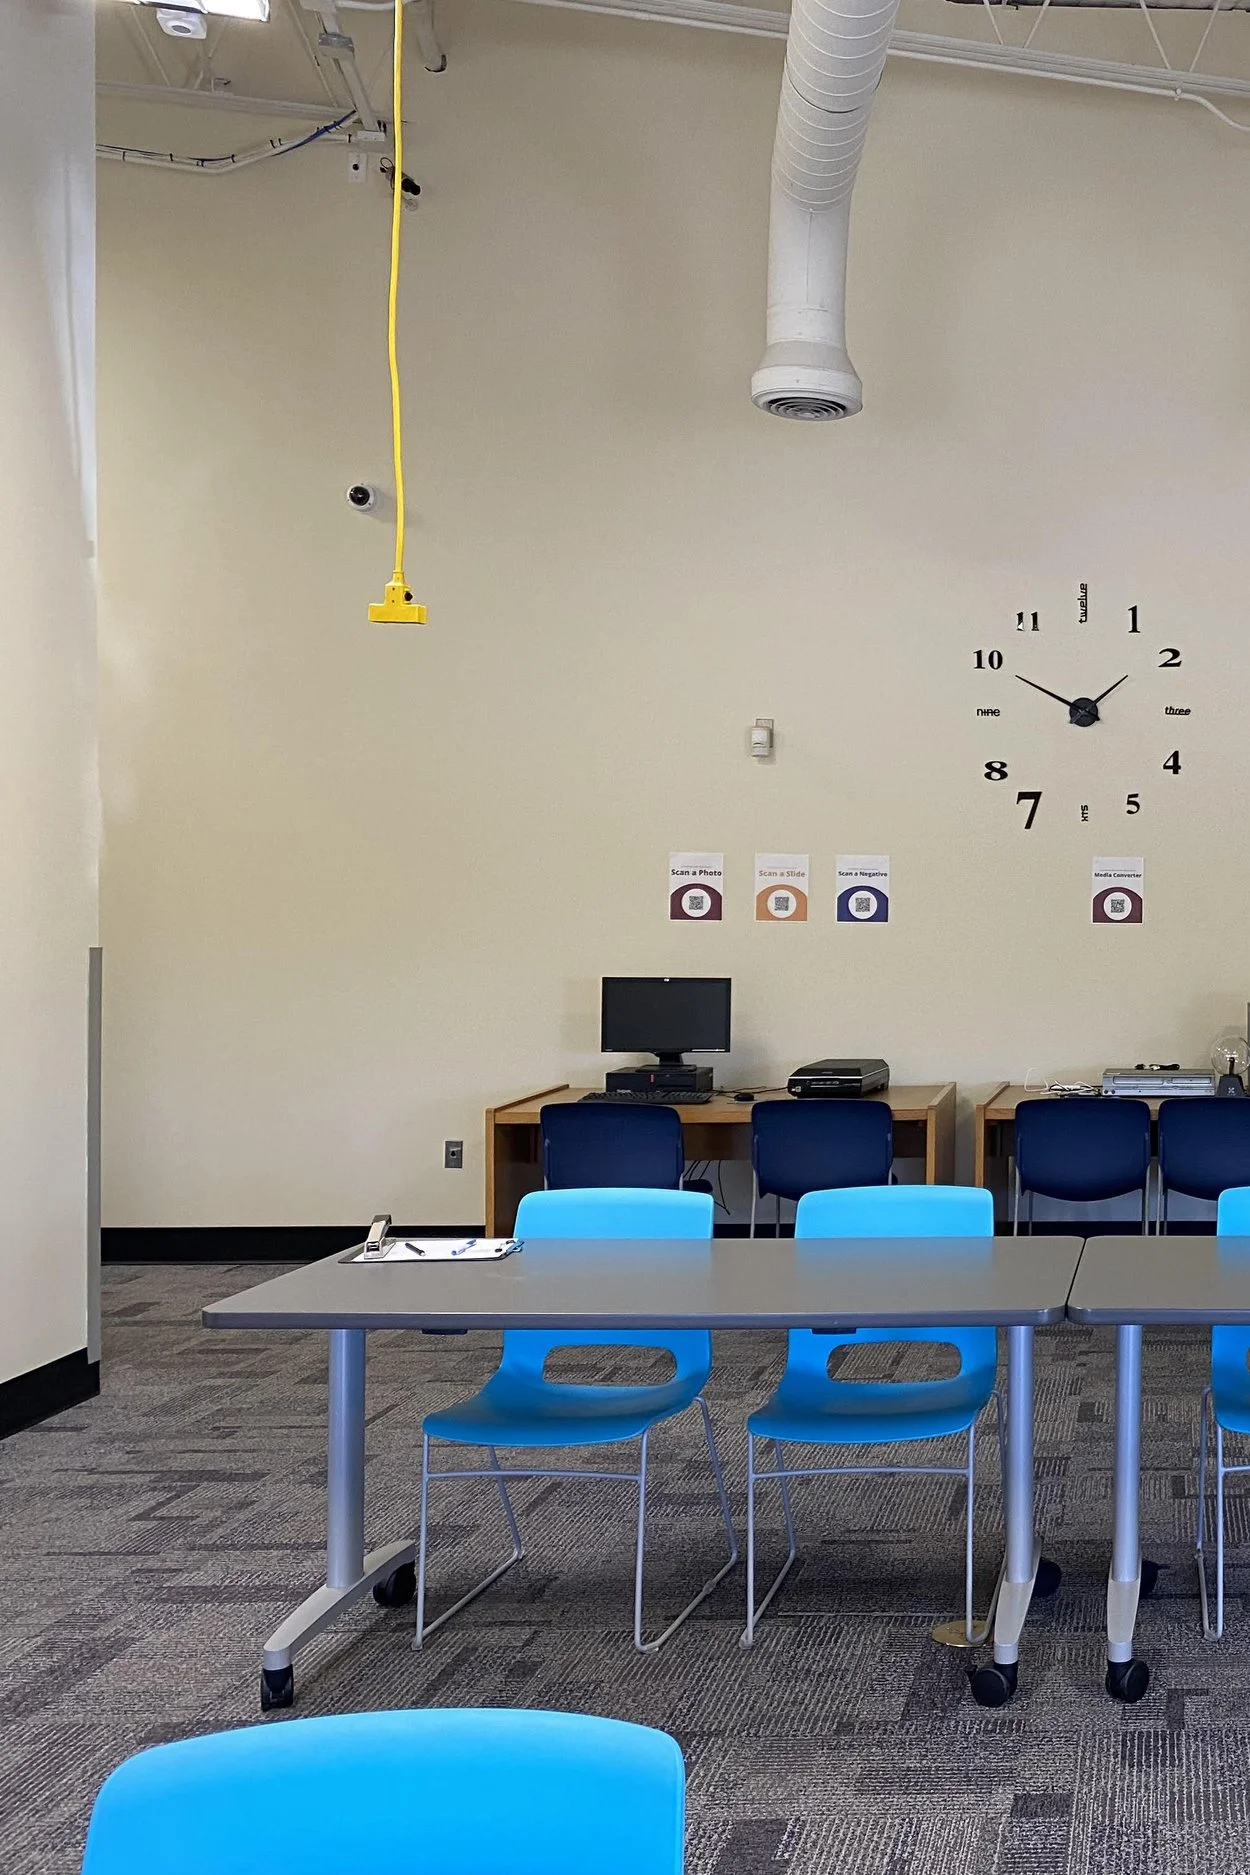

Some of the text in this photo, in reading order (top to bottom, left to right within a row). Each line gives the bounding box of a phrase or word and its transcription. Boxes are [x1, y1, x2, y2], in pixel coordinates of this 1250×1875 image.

[1077, 582, 1088, 624] twelve
[1016, 611, 1040, 632] 11
[1127, 604, 1141, 634] 1
[972, 649, 1004, 670] 10
[1158, 647, 1182, 668] 2
[976, 707, 1001, 717] nine
[1164, 705, 1192, 716] three
[983, 760, 1009, 781] 8
[1162, 750, 1182, 775] 4
[1016, 791, 1043, 829] 7
[1126, 793, 1141, 815] 5
